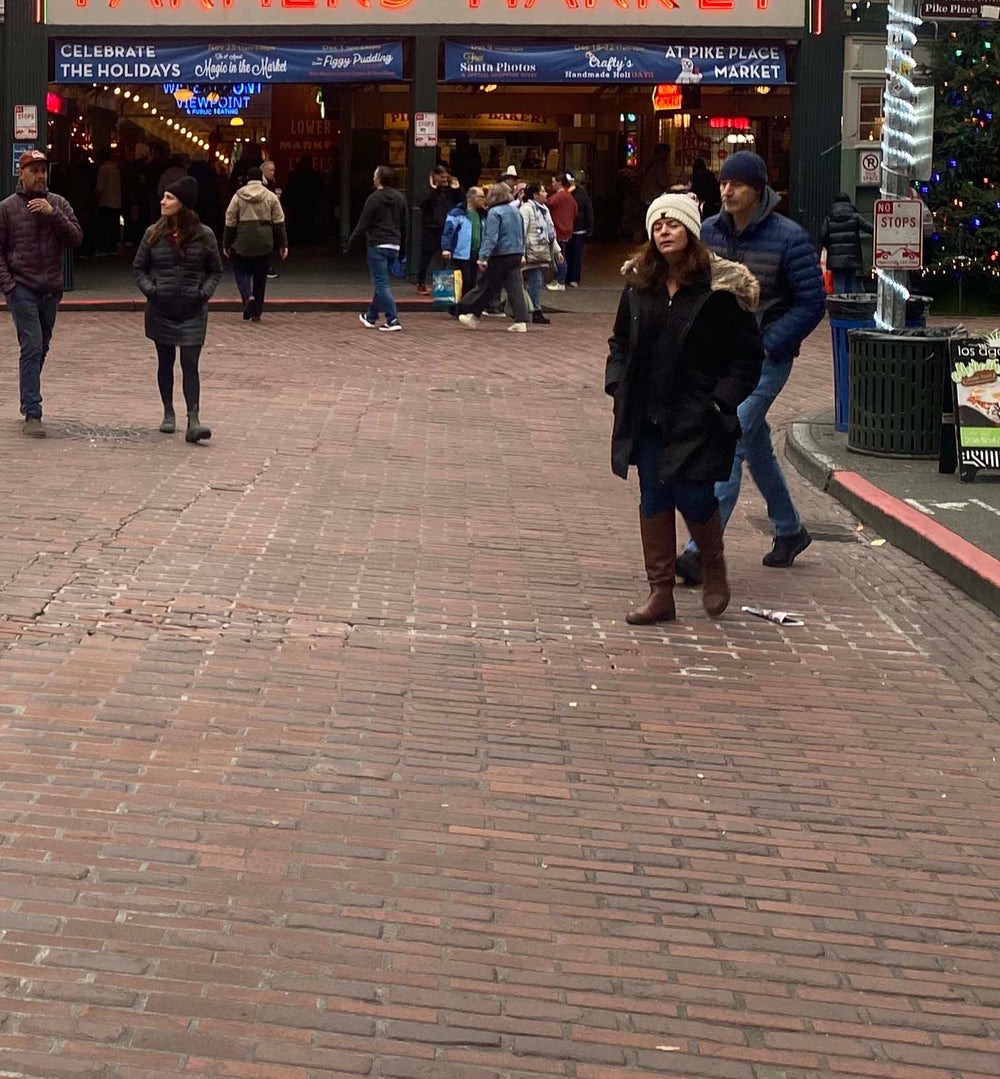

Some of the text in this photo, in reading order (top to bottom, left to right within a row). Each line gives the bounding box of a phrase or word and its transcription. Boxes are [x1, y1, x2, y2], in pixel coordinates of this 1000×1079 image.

[925, 3, 978, 14] Pike Place
[60, 45, 156, 58] CELEBRATE
[665, 45, 780, 60] AT PIKE PLACE
[323, 54, 352, 69] Figgy
[352, 52, 394, 66] Pudding
[460, 61, 537, 72] Santa Photos
[588, 56, 634, 72] Crafty's
[60, 63, 181, 78] THE HOLIDAYS
[195, 56, 287, 80] Magic in the Market
[714, 65, 781, 79] MARKET
[565, 71, 610, 79] Handmade
[176, 96, 251, 109] VIEWPOINT
[290, 119, 331, 135] LOWER
[279, 140, 331, 151] MARKE
[877, 203, 891, 213] NO
[881, 216, 916, 228] STOPS
[958, 345, 976, 357] los
